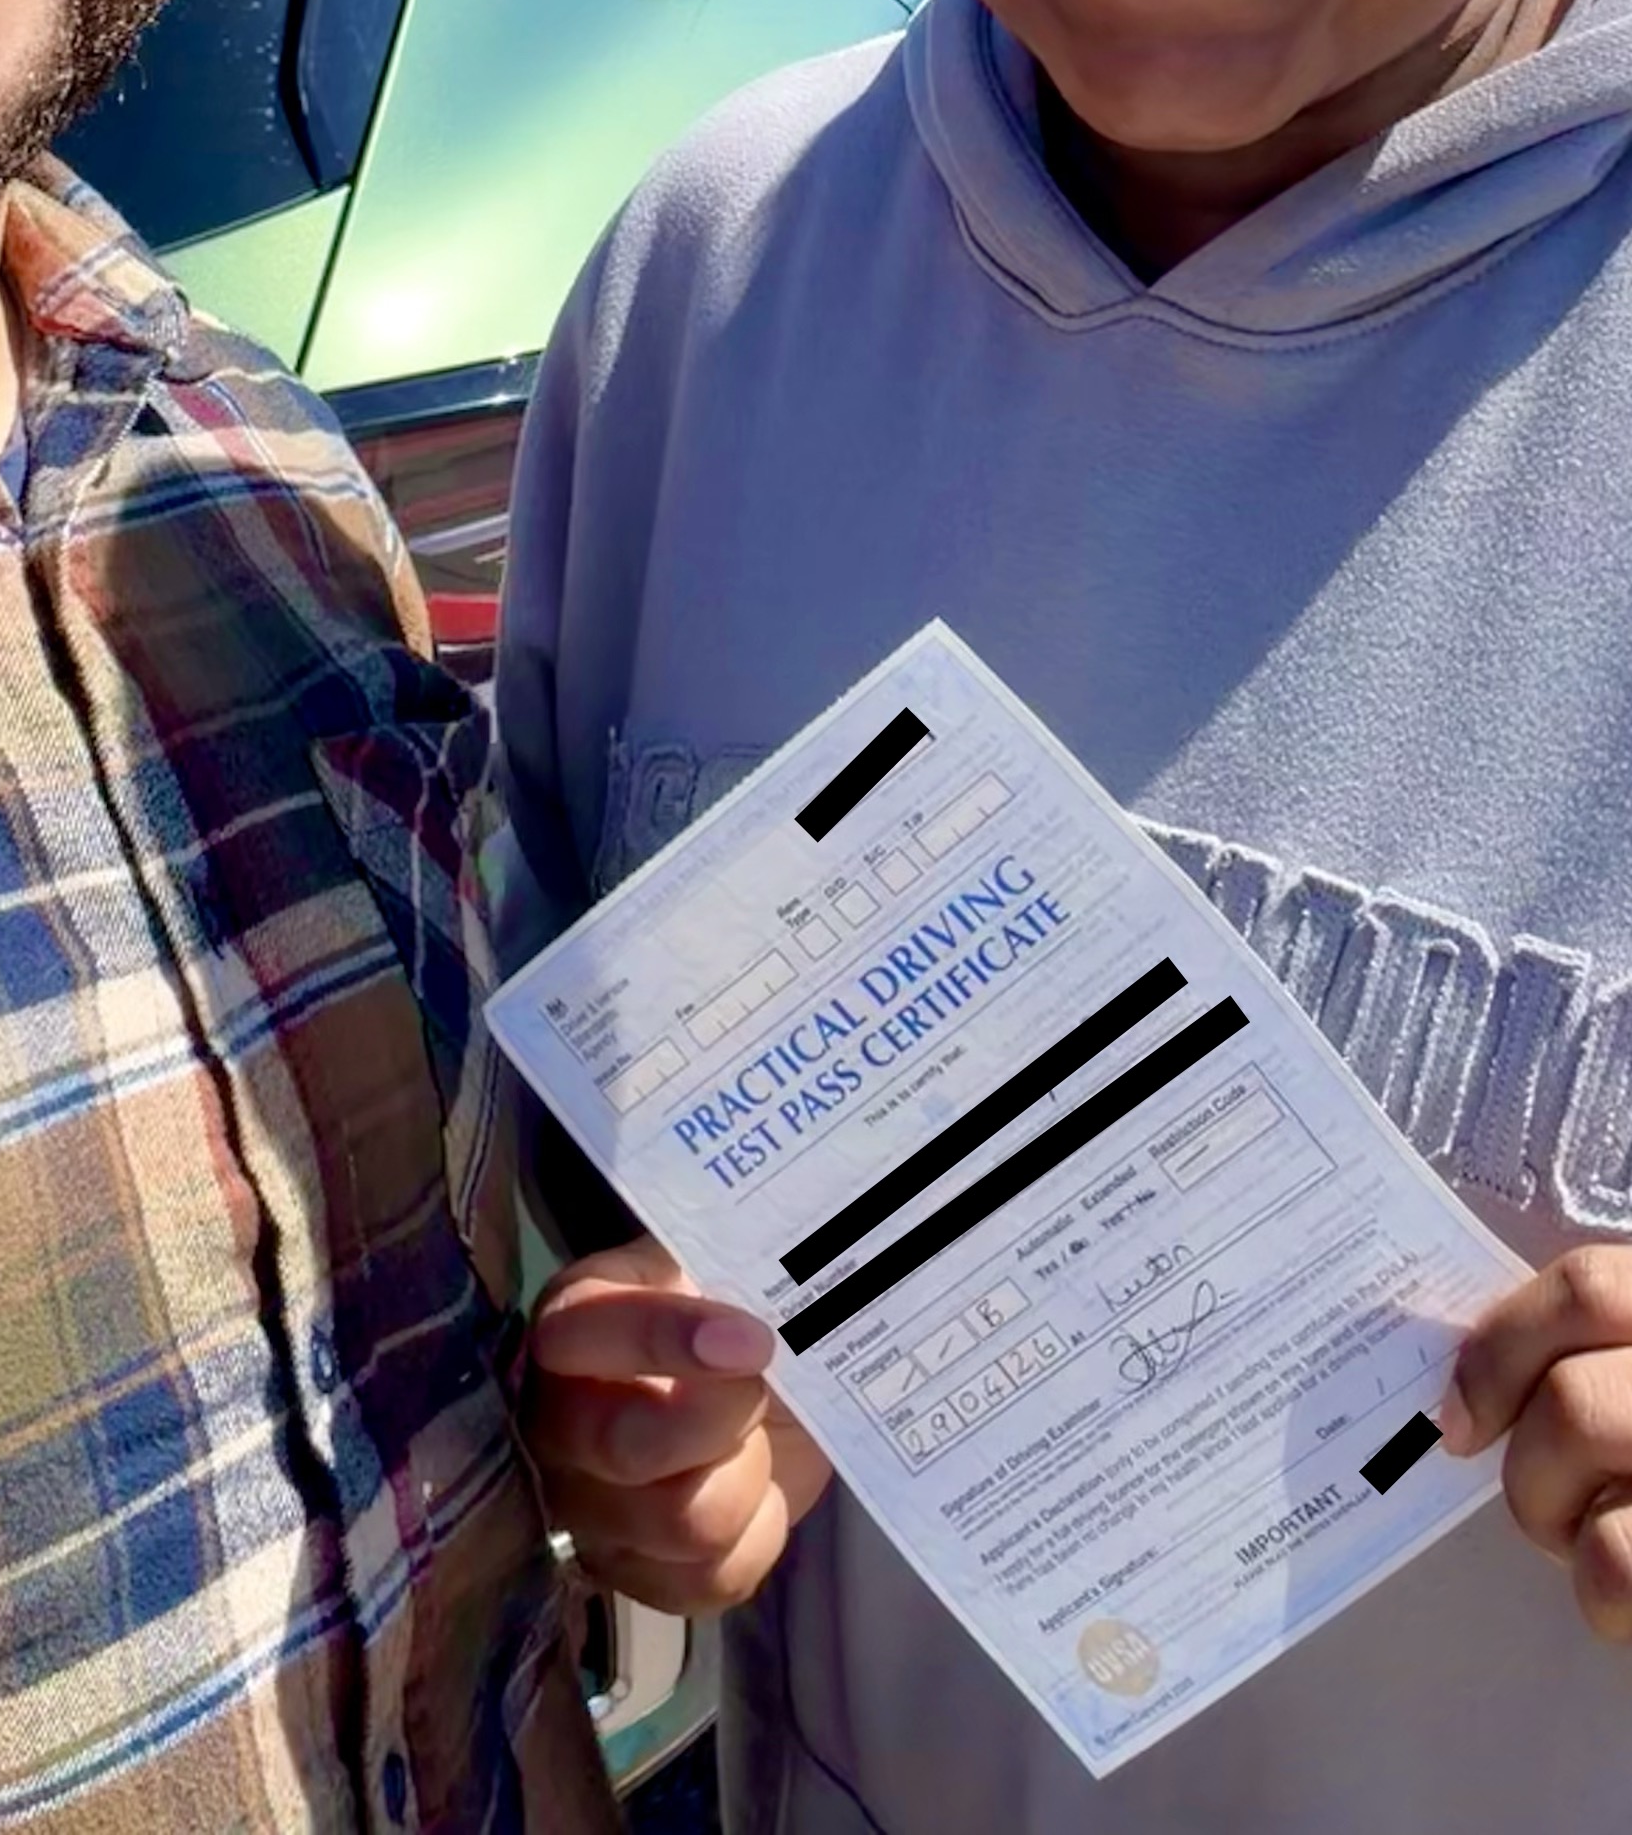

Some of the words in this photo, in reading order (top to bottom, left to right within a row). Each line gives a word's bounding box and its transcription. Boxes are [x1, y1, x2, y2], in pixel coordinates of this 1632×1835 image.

[670, 985, 869, 1161] PRACTICAL
[856, 851, 1038, 1010] DRIVING
[702, 1116, 787, 1195] TEST
[774, 1053, 867, 1138] PASS
[854, 886, 1072, 1074] CERTIFICATE
[1145, 1102, 1216, 1162] Restriction
[1209, 1078, 1249, 1114] Code
[1078, 1161, 1139, 1213] Extended
[1011, 1209, 1076, 1264] Automatic
[1032, 1256, 1060, 1282] Yes
[972, 1295, 1007, 1330] B
[823, 1347, 851, 1373] Has
[844, 1316, 891, 1357] Passed
[847, 1340, 905, 1391] Category
[883, 1403, 916, 1432] Date
[938, 1471, 997, 1522] Signature
[990, 1462, 1010, 1481] of
[1004, 1431, 1053, 1474] Driving
[1044, 1392, 1104, 1443] Examiner
[1037, 1469, 1106, 1525] Declaration
[1232, 1479, 1346, 1569] IMPORTANT
